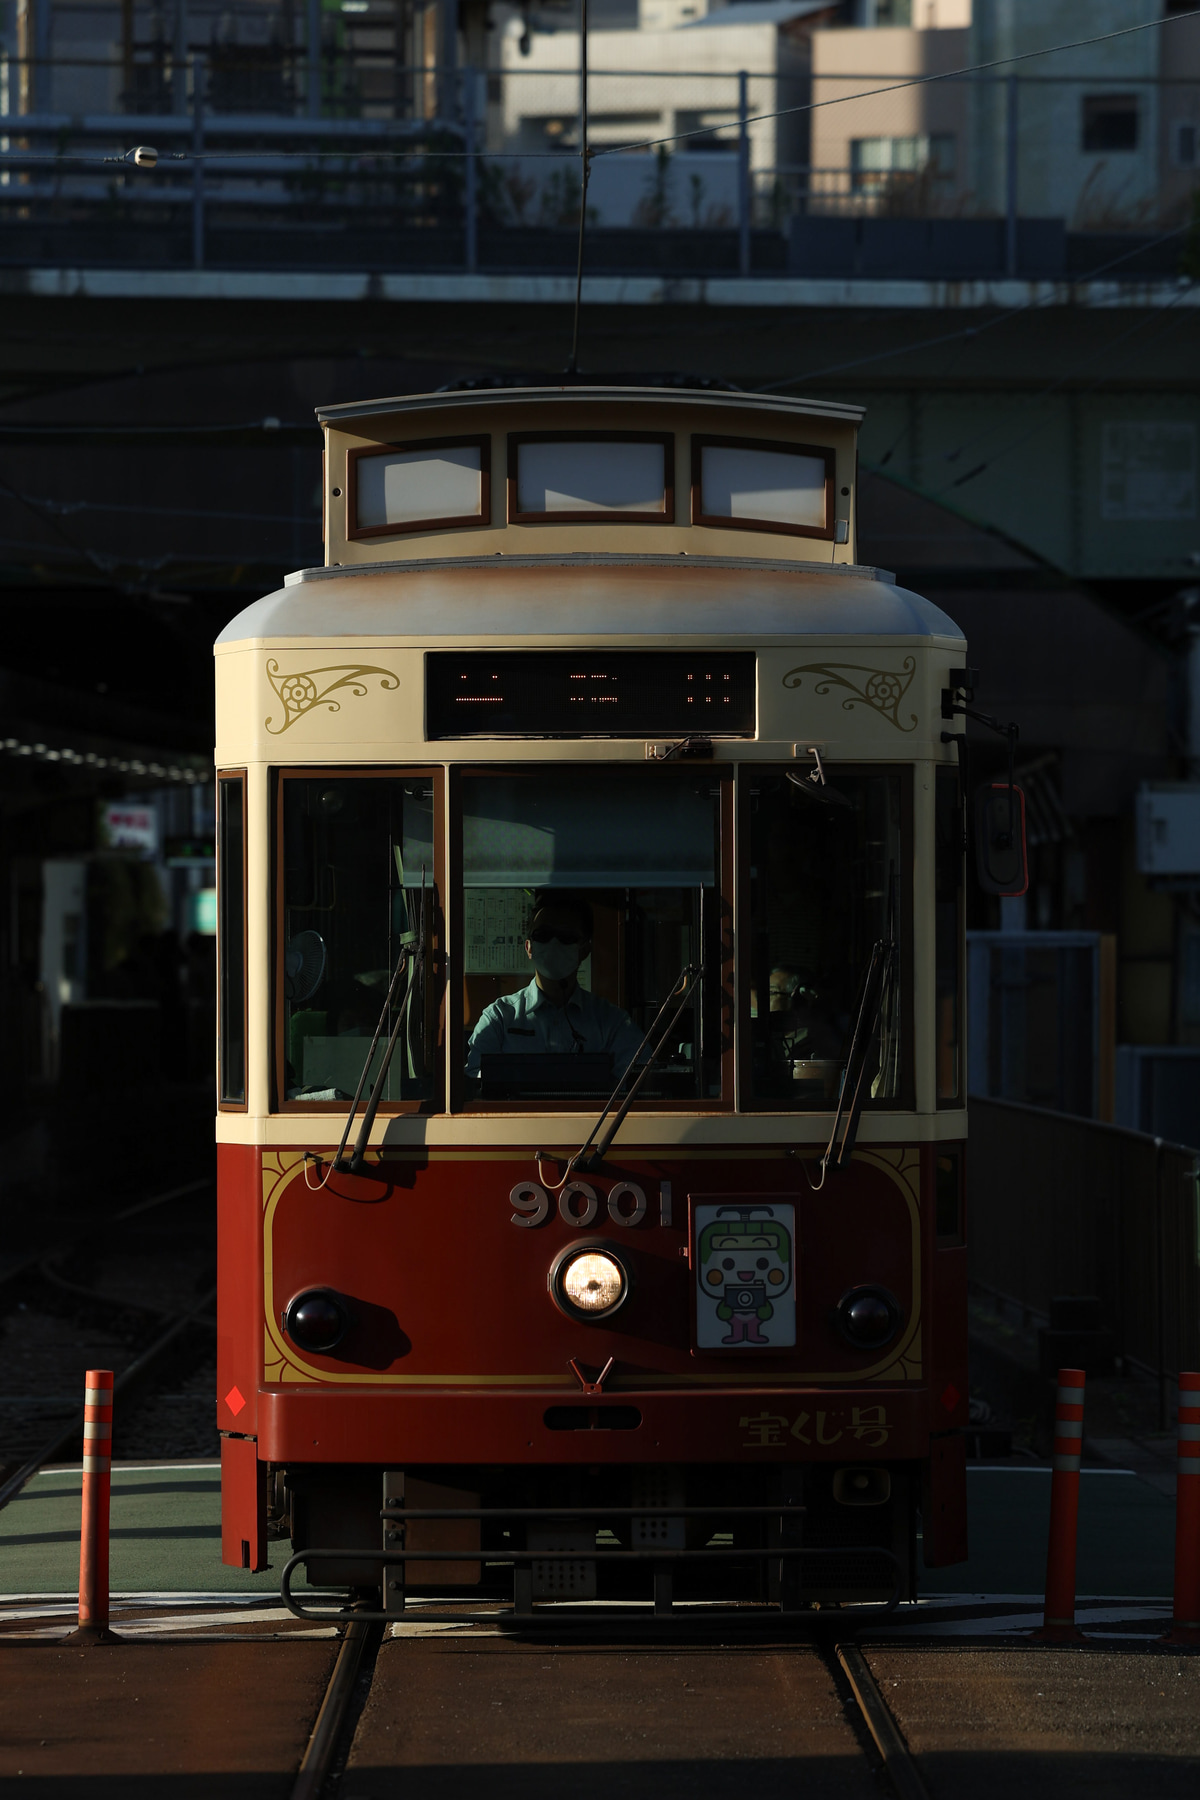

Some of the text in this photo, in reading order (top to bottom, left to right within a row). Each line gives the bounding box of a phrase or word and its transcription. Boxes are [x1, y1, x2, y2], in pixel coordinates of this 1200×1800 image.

[509, 1181, 672, 1228] 9001
[738, 1405, 894, 1448] 宝くじ号
